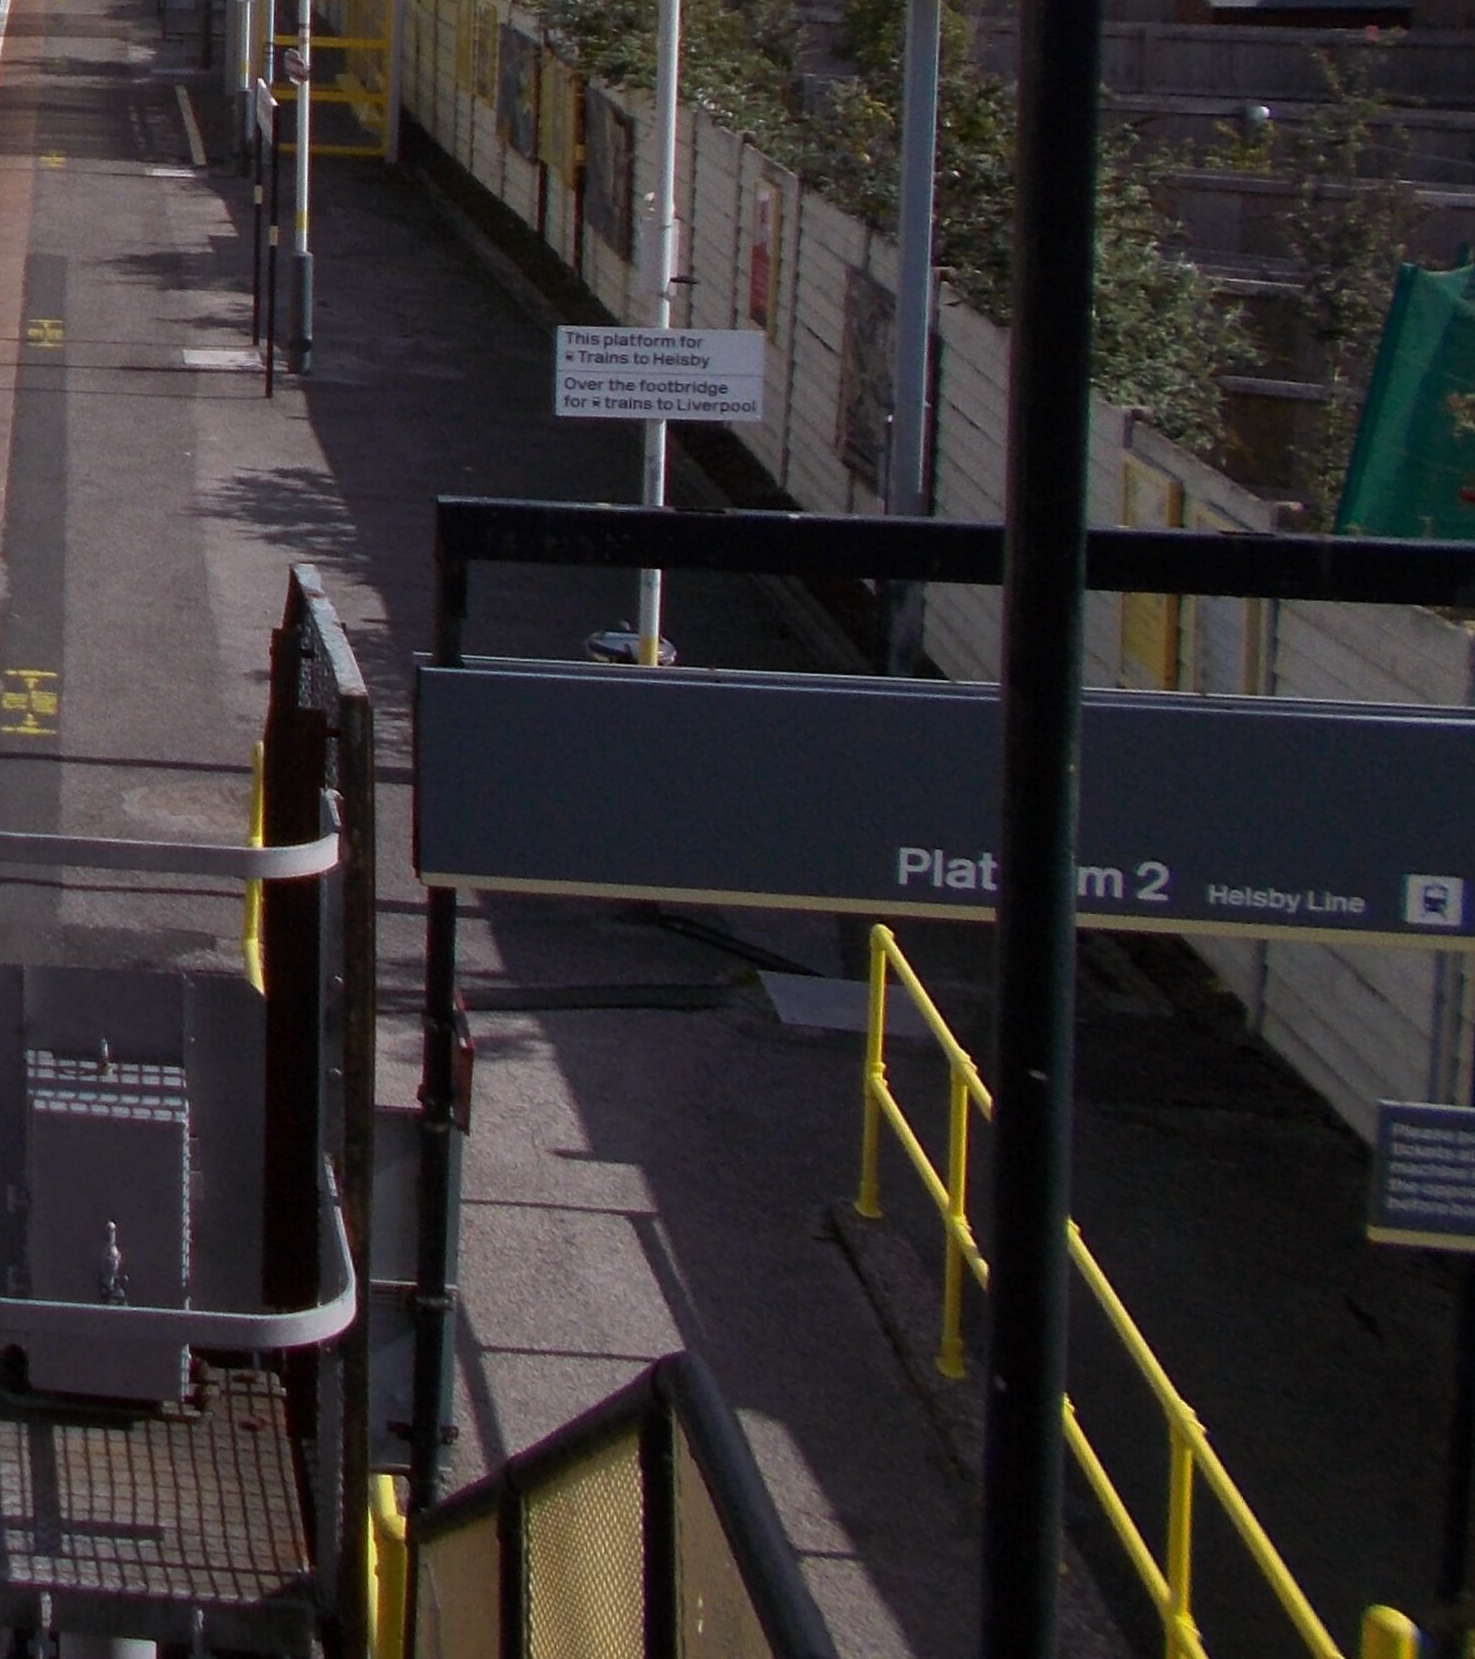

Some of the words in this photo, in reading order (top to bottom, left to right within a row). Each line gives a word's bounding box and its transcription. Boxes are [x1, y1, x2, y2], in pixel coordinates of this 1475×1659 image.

[565, 331, 600, 346] This
[603, 333, 676, 349] platform
[680, 335, 704, 348] for
[578, 350, 629, 365] Trains
[634, 351, 649, 365] to
[652, 352, 711, 369] Helsby
[564, 377, 603, 391] Over
[608, 377, 635, 392] the
[640, 379, 729, 395] footbridge
[564, 394, 587, 408] for
[604, 395, 653, 410] trains
[657, 397, 674, 411] to
[677, 398, 757, 414] Liverpool
[897, 845, 1124, 901] Platm
[1136, 861, 1172, 903] 2
[1208, 884, 1301, 914] Helsby
[1307, 890, 1367, 914] Line
